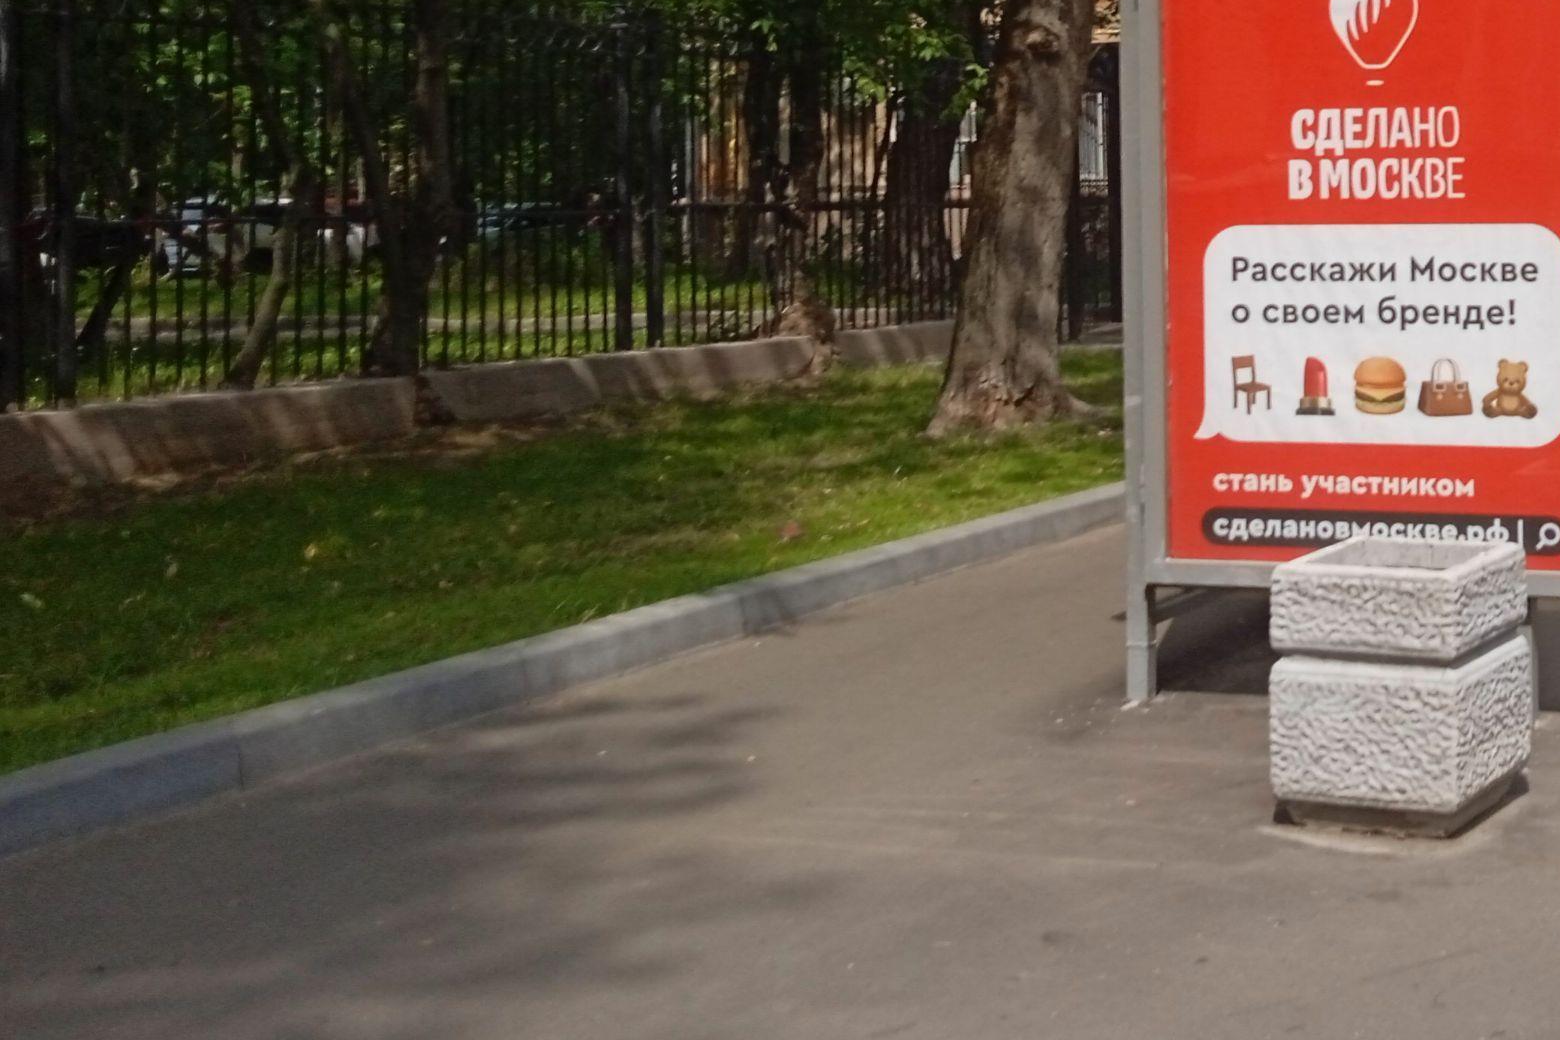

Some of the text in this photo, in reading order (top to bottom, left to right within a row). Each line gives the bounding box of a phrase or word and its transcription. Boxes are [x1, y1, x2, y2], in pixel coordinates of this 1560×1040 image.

[1290, 105, 1460, 157] СДЕЛАНО
[1287, 157, 1466, 200] В МОСКВЕ
[1231, 256, 1539, 283] Расскажи Москве
[1231, 295, 1517, 331] о своем бренде!
[1212, 471, 1475, 499] стань участником
